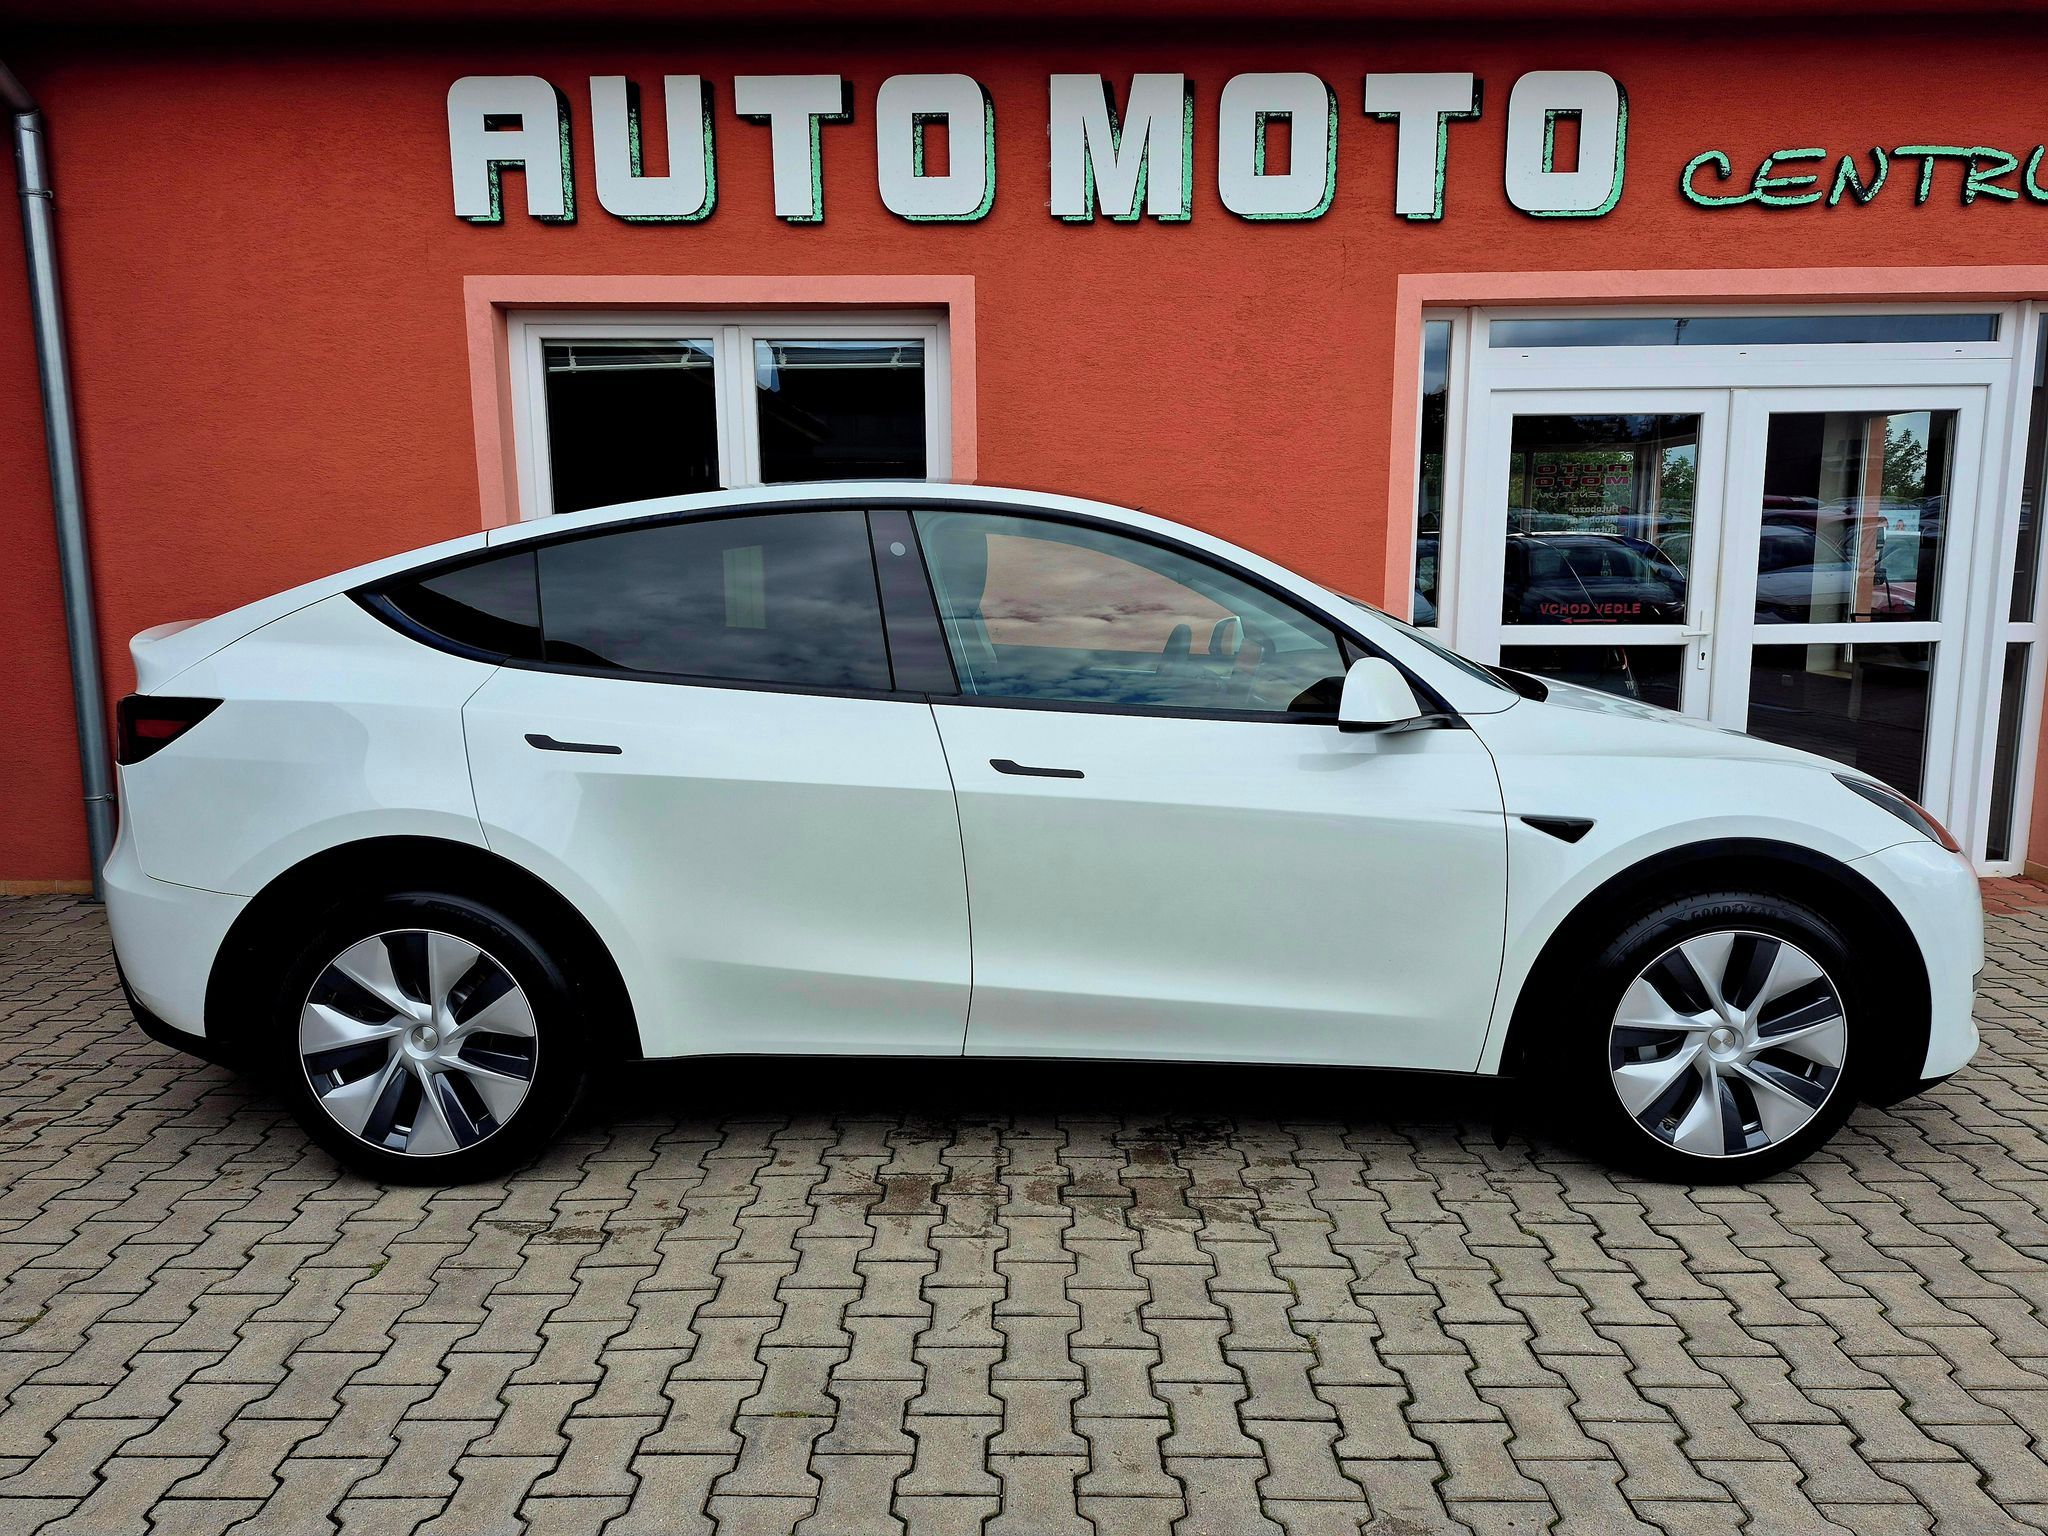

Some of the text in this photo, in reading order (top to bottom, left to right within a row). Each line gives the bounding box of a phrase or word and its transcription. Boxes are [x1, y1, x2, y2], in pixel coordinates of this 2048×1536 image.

[447, 70, 1629, 225] AUTO MOTO
[1539, 602, 1641, 615] VCHOD VEDLE
